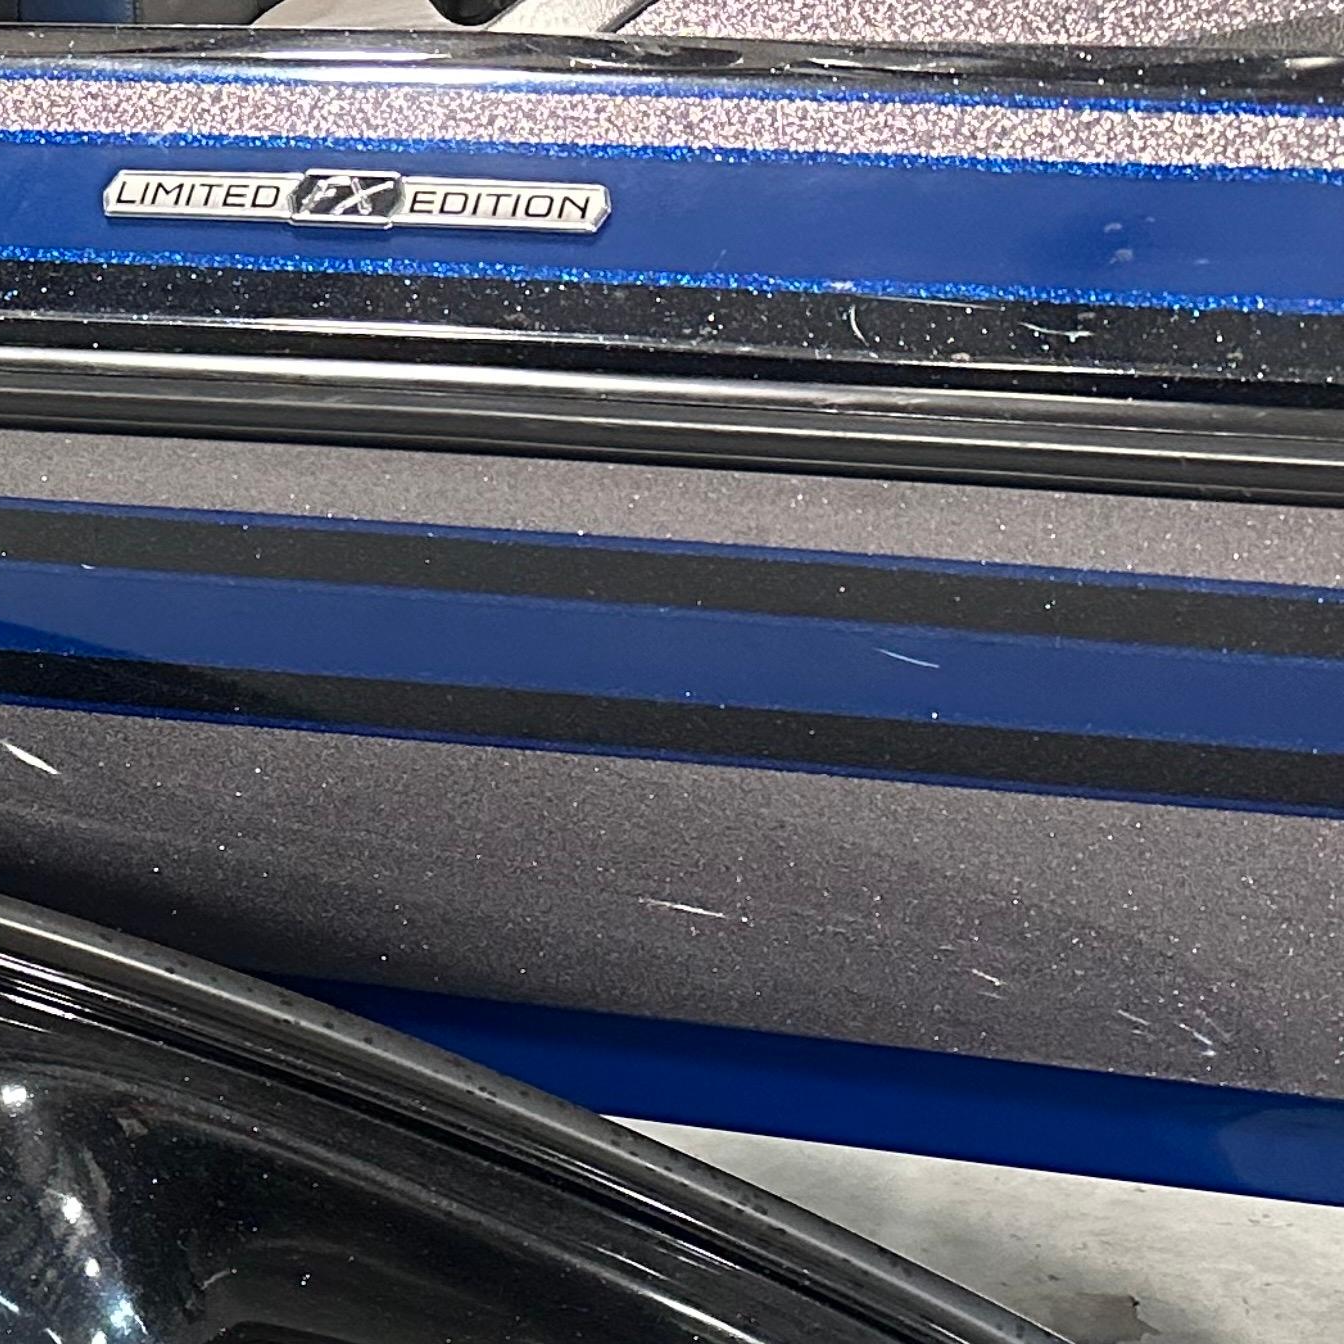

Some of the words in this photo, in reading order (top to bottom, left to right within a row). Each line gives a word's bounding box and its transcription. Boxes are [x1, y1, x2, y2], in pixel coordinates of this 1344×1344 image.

[115, 180, 281, 209] LIMITED
[298, 175, 395, 216] FX
[409, 190, 592, 219] EDITION
